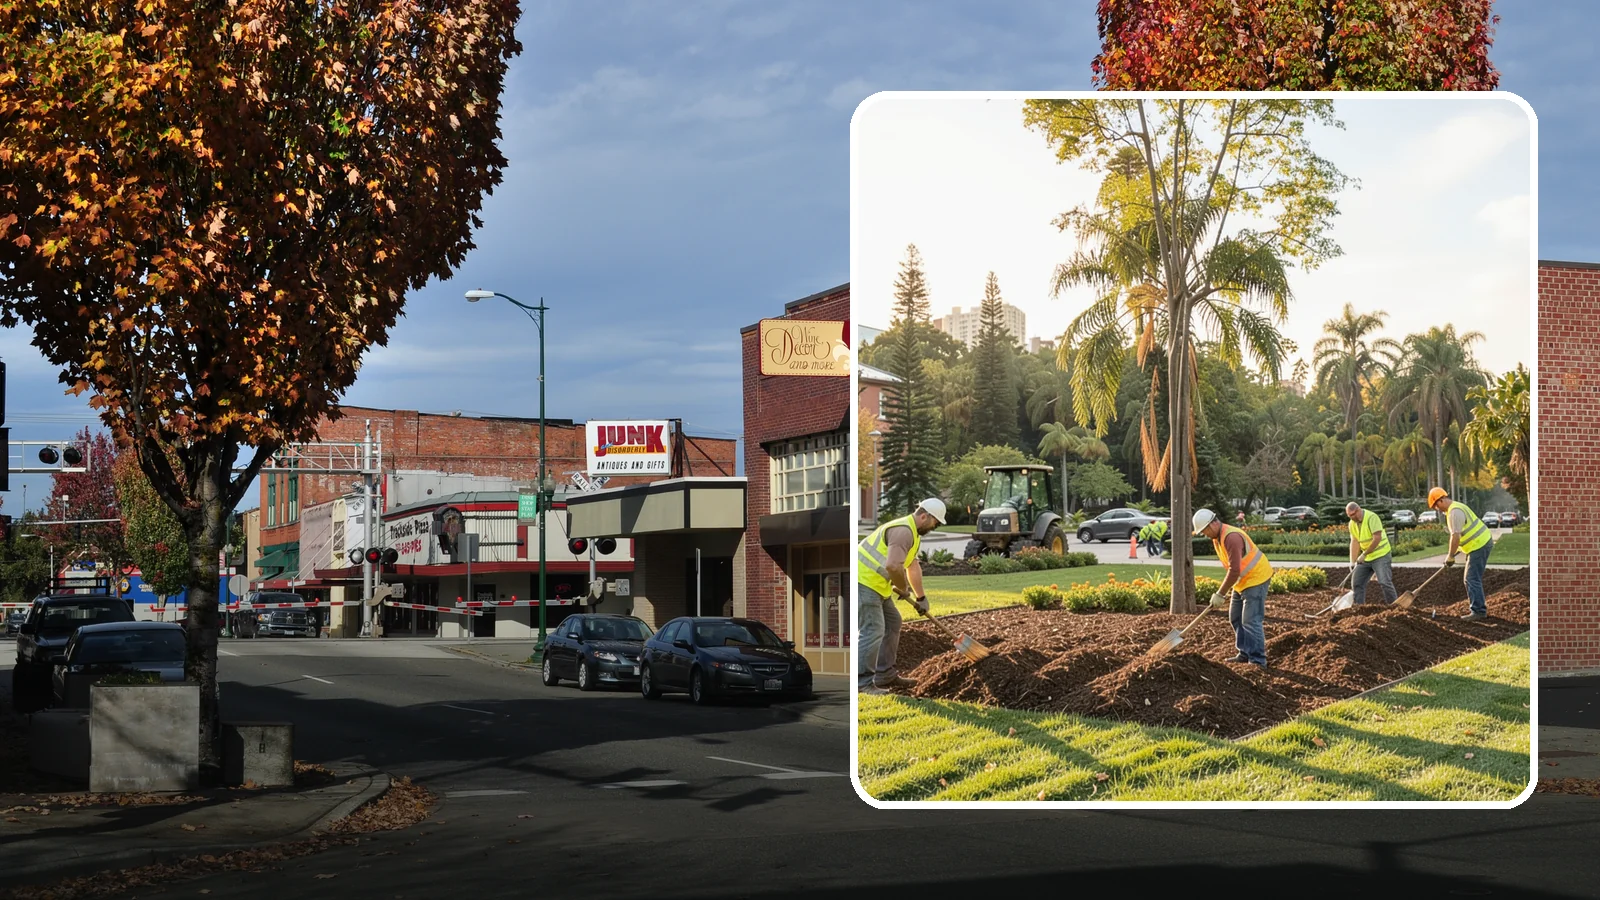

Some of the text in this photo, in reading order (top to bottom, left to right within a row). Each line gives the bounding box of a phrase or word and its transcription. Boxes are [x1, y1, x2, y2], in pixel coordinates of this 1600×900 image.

[791, 325, 824, 344] Wine
[765, 328, 830, 365] Decor
[596, 425, 665, 457] JUNK
[607, 446, 645, 454] DISORDERLY
[597, 460, 665, 470] ANTIQUES AND GIFTS
[573, 473, 588, 490] RAIL
[390, 519, 429, 539] Trackside Pizza
